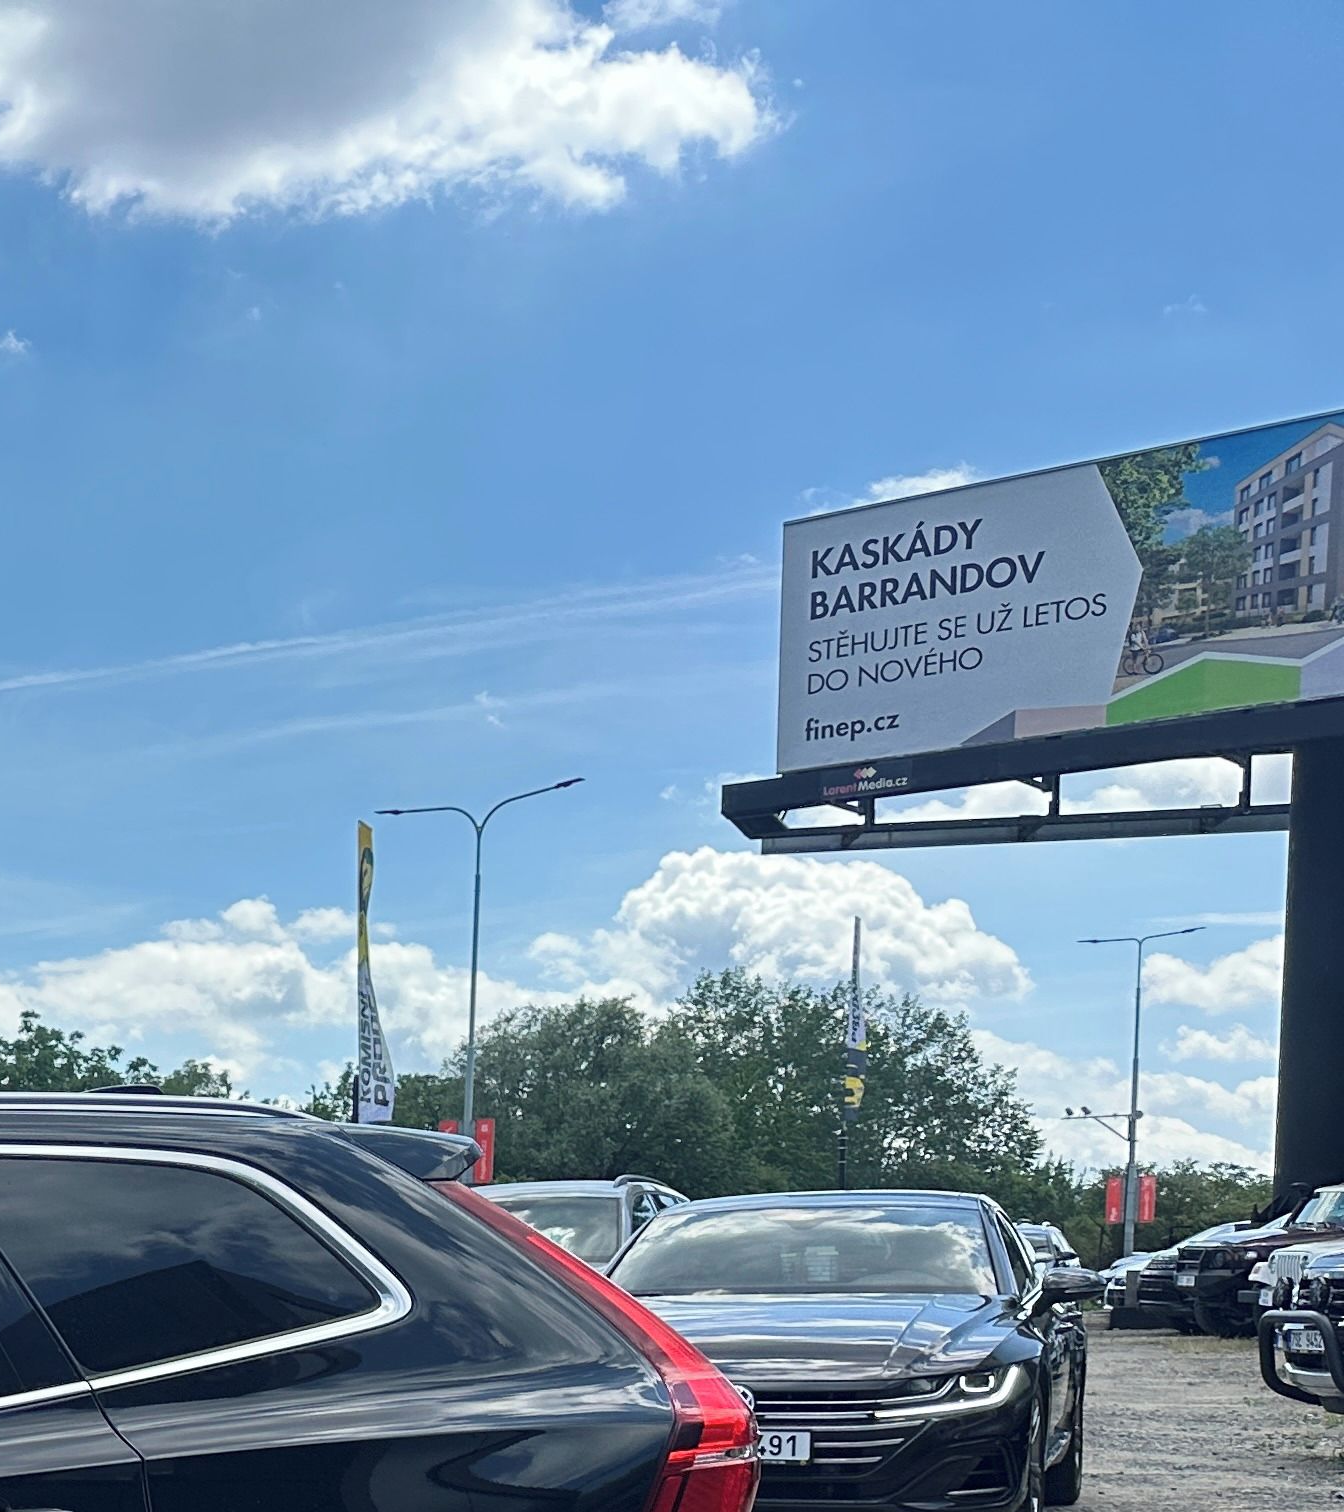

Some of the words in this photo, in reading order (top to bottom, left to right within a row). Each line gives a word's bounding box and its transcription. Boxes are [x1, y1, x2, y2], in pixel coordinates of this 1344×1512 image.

[811, 518, 983, 579] KASKÁDY
[810, 551, 1046, 620] BARRANDOV
[808, 621, 928, 663] STĚHUJTE
[937, 615, 967, 641] SE
[977, 602, 1013, 634] UŽ
[1022, 592, 1108, 629] LETOS
[807, 668, 849, 695] DO
[858, 647, 983, 687] NOVÉHO
[805, 713, 900, 742] finep.cz
